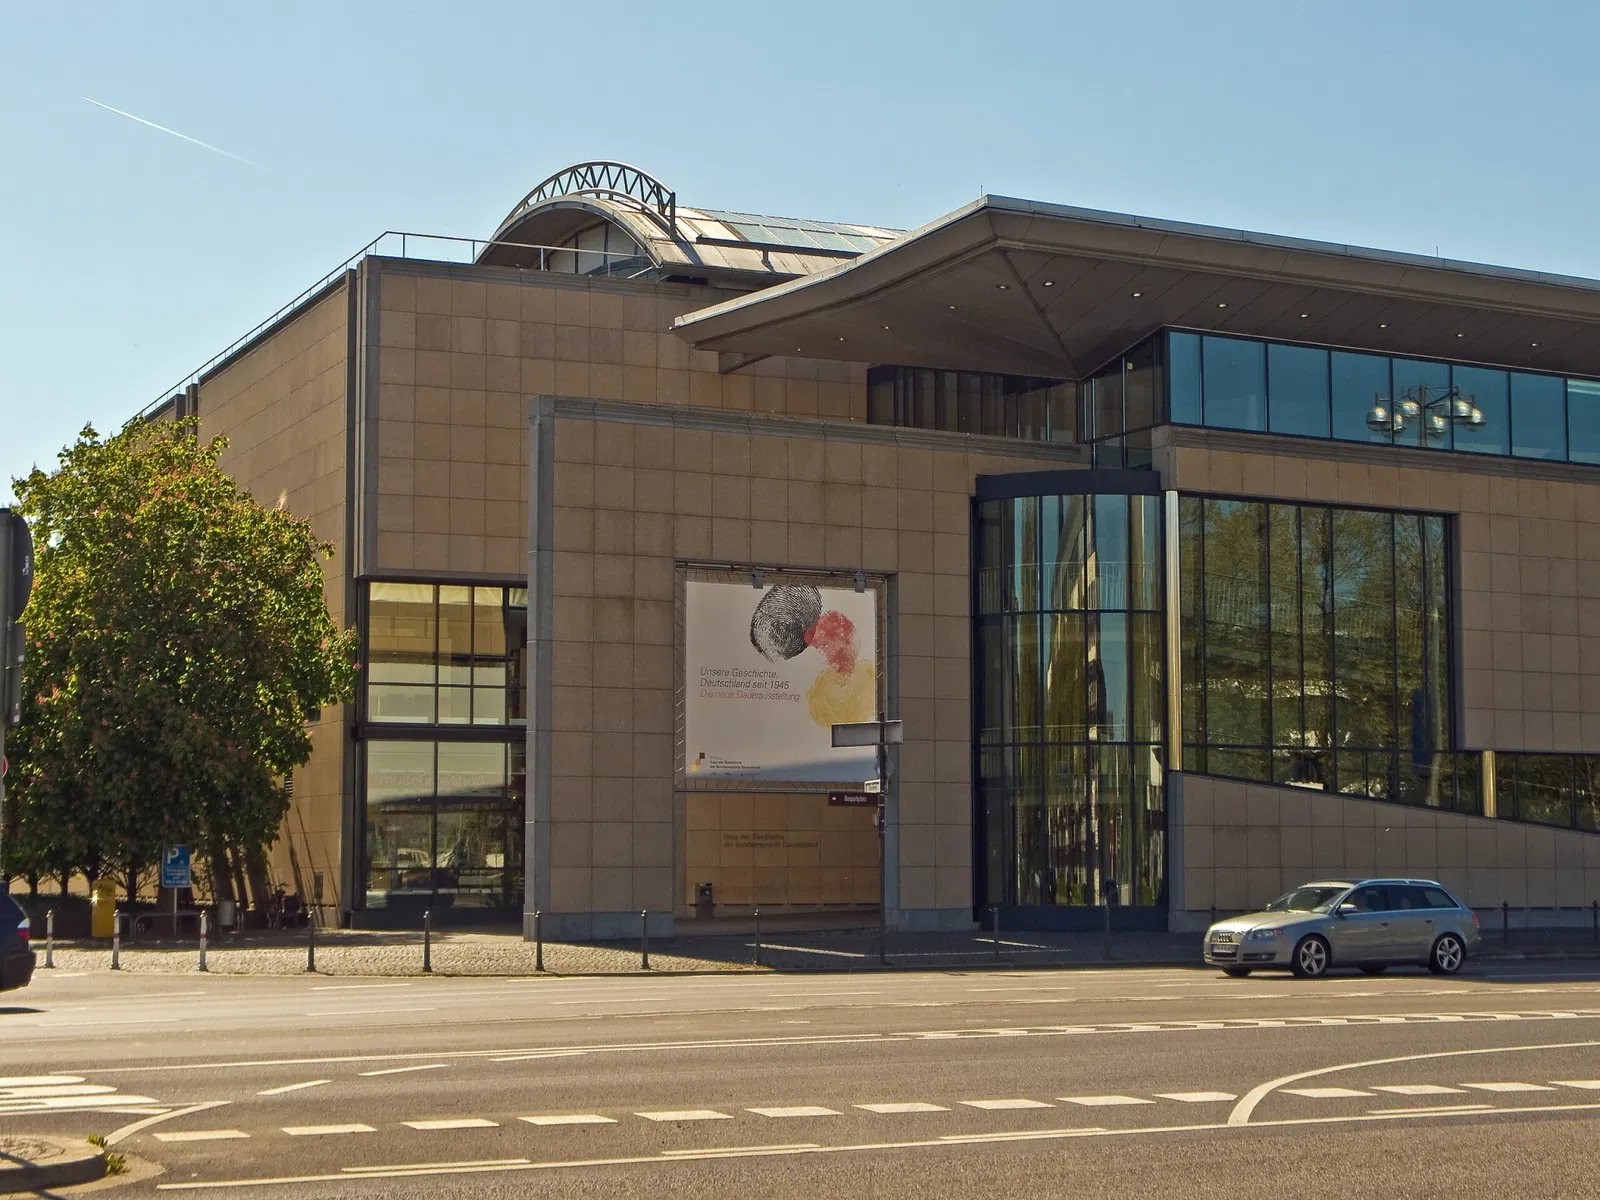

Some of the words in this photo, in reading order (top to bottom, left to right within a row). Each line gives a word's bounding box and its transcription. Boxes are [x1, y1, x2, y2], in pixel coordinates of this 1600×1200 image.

[700, 667, 729, 677] Unsere
[732, 668, 779, 678] Geschichte.
[700, 678, 751, 688] Deutschland
[752, 680, 767, 689] seit
[770, 680, 790, 690] 1945
[700, 689, 713, 699] Die
[716, 691, 734, 699] neue
[737, 690, 800, 702] Dauerausstellung
[167, 848, 179, 864] P
